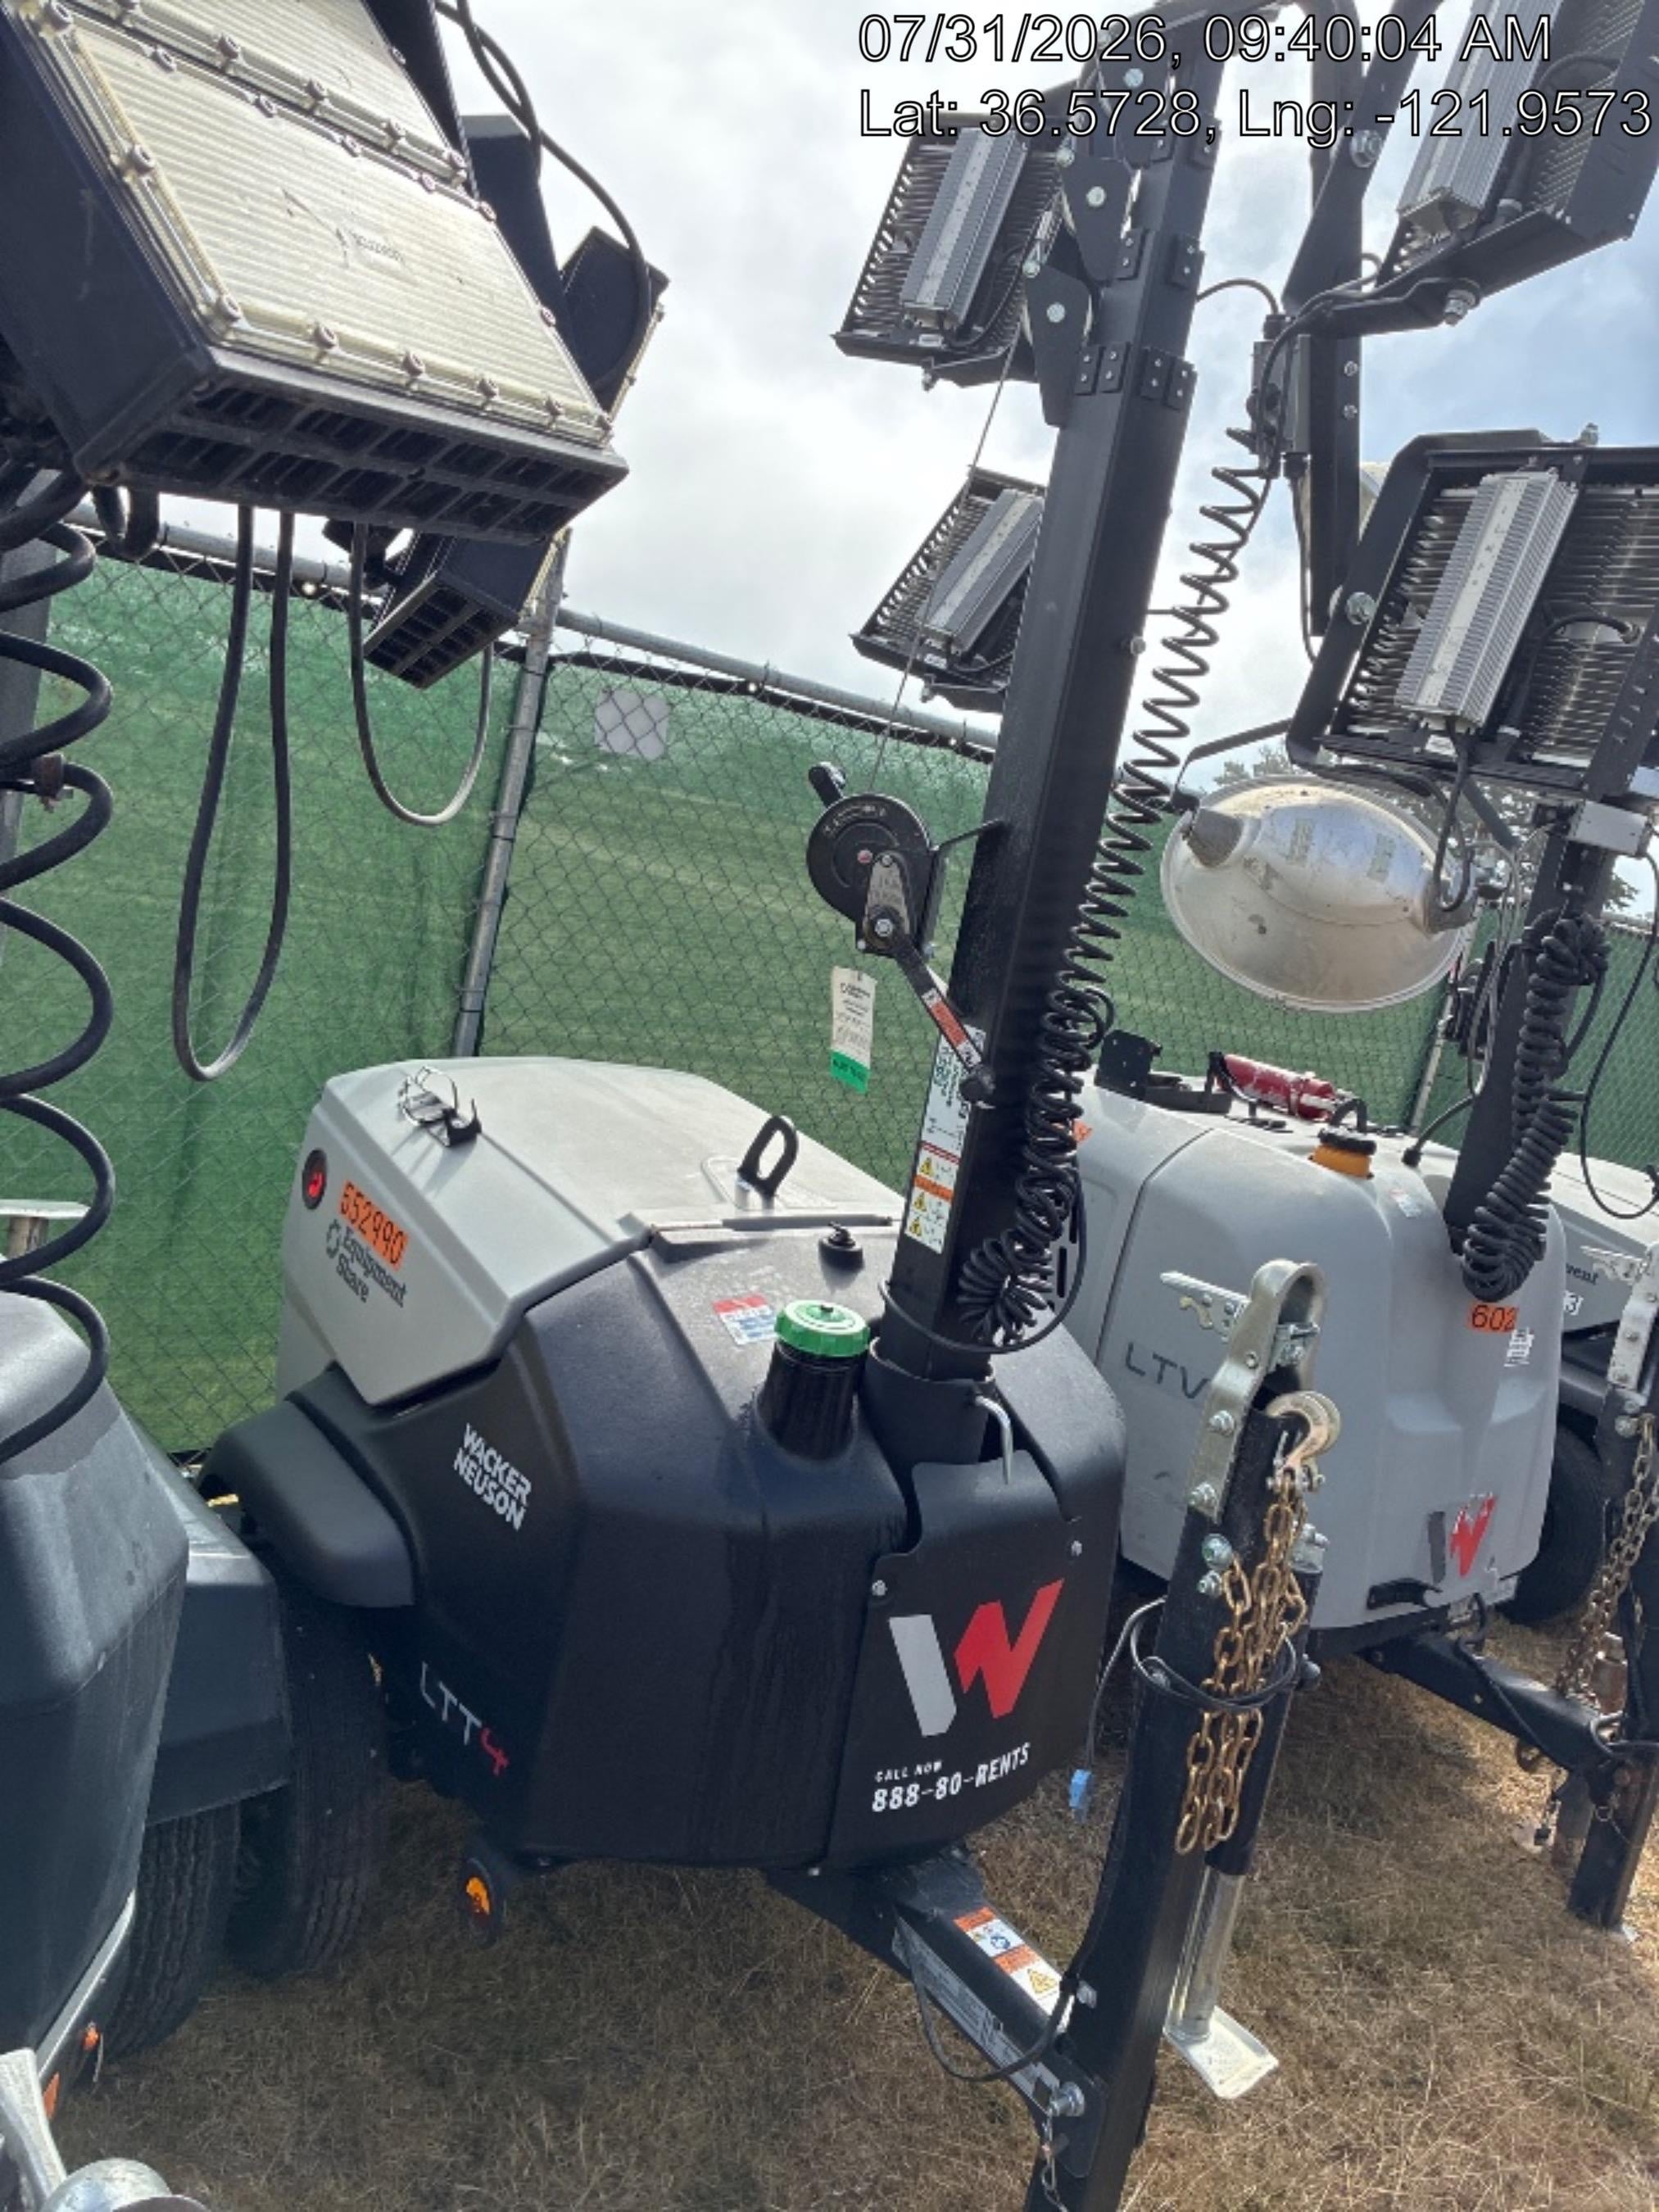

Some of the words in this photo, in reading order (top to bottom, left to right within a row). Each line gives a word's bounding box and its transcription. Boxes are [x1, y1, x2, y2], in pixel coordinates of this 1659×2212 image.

[337, 1253, 369, 1303] Share
[343, 1226, 407, 1308] Equipment
[453, 1447, 526, 1531] NEUSON
[463, 1422, 532, 1506] WACKER
[419, 1661, 510, 1776] LTT4
[872, 1742, 1031, 1812] 888-80-RENTS
[875, 1766, 909, 1783] CALL
[913, 1760, 942, 1776] NOW
